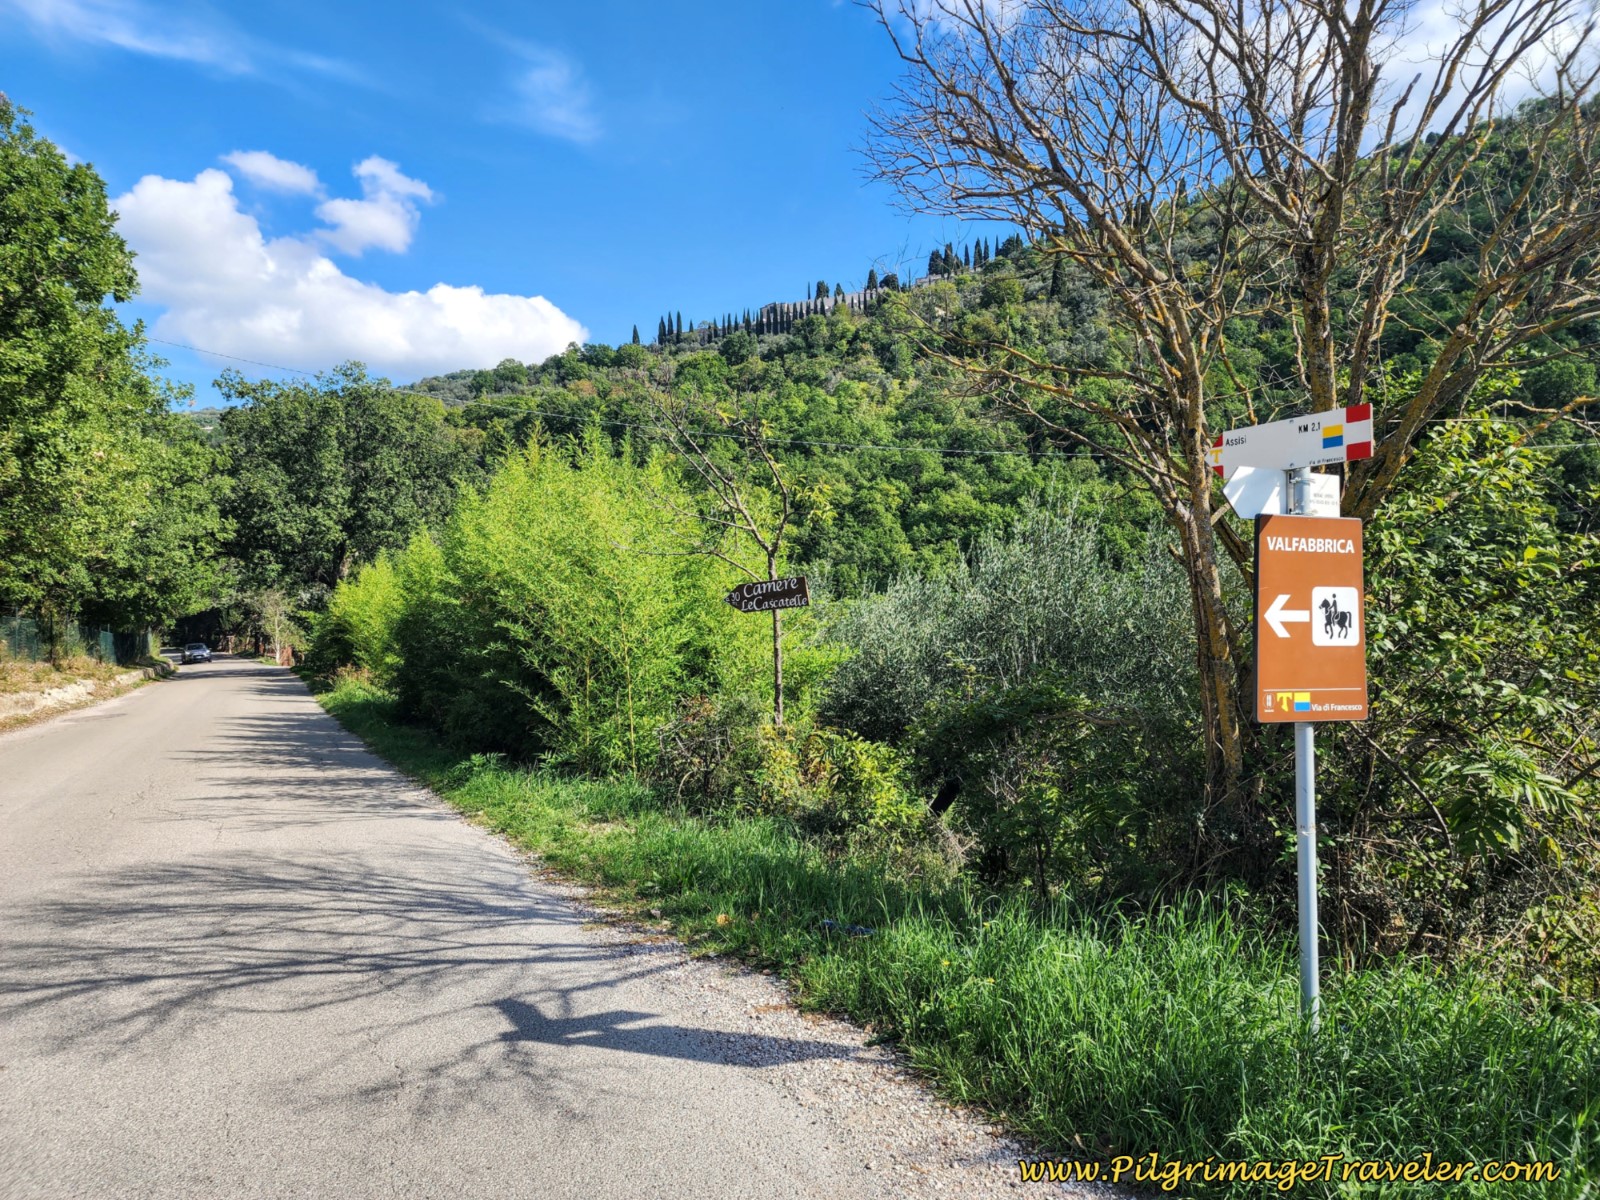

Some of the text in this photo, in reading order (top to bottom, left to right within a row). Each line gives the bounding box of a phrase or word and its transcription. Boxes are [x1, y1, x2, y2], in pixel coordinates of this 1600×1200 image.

[1298, 422, 1321, 434] KM 2.1
[1225, 435, 1247, 447] Assisi
[1267, 536, 1355, 554] VALFABBRICA
[743, 578, 799, 598] Camere
